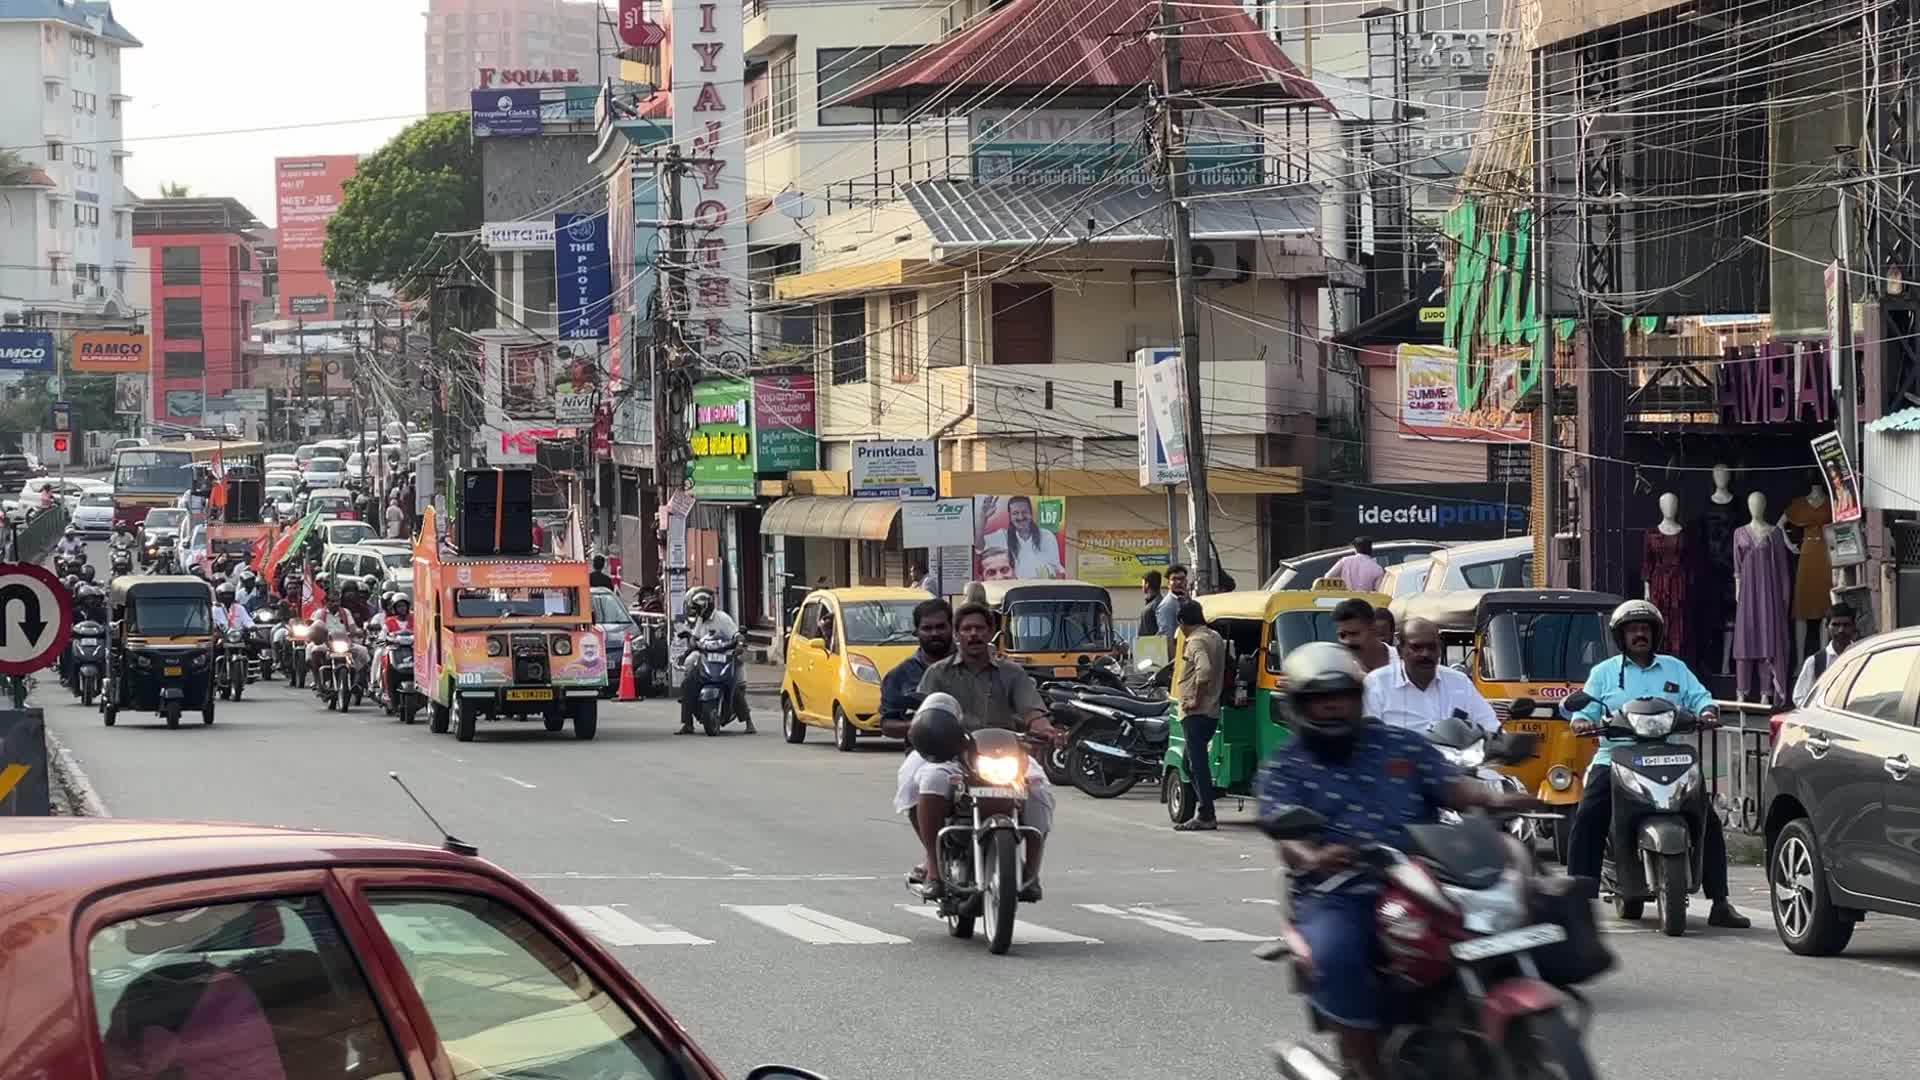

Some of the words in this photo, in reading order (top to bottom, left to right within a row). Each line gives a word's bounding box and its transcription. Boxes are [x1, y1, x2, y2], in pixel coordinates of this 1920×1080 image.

[479, 67, 496, 88] F
[501, 68, 580, 85] SQUARE
[569, 243, 595, 252] THE
[1423, 311, 1446, 320] JUDO
[81, 343, 143, 355] RAMCO
[857, 446, 924, 458] Printkada
[1041, 511, 1058, 524] LDF
